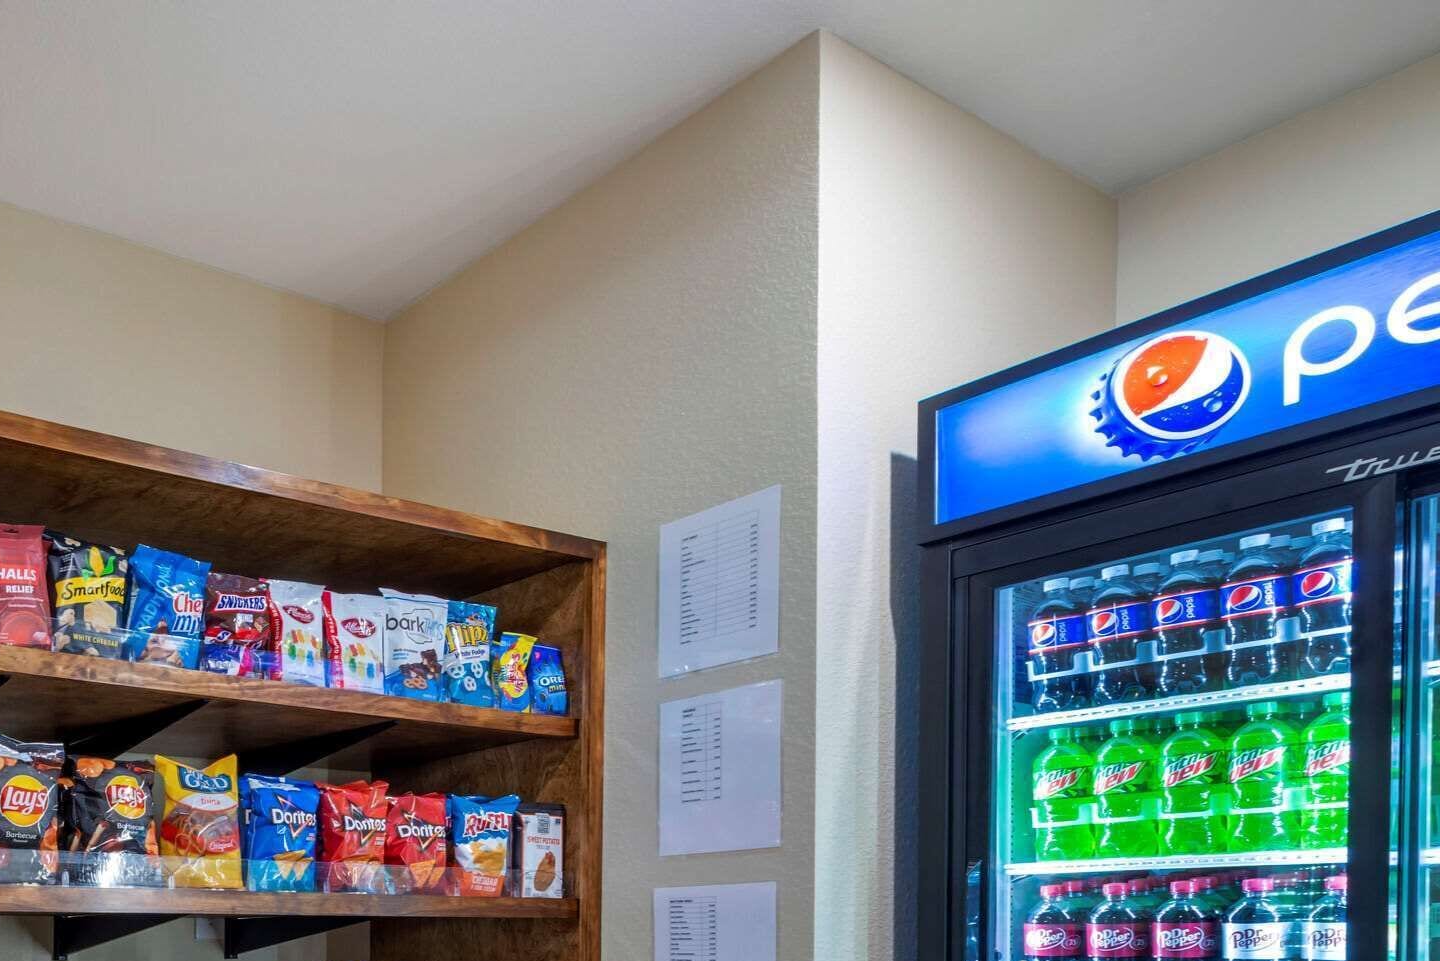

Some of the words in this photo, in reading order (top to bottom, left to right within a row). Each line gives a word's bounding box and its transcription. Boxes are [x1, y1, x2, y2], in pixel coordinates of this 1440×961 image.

[5, 585, 34, 594] RELIEF
[1263, 580, 1273, 605] pepsi
[173, 592, 203, 613] Che
[217, 595, 265, 610] SNICKERS
[1185, 597, 1195, 619] pepsi
[1121, 609, 1130, 630] pepsi
[72, 633, 92, 642] WHITE
[3, 786, 48, 817] Lay's
[272, 809, 316, 825] Doritos
[344, 816, 386, 831] Doritos
[465, 812, 513, 837] RUFFL
[5, 831, 38, 840] Barbecue
[398, 824, 446, 838] Doritos
[1103, 928, 1119, 939] Dr
[1160, 929, 1201, 949] Pepper
[1171, 928, 1189, 938] Dr
[1232, 930, 1272, 949] Pepper
[1245, 928, 1263, 938] Dr
[1311, 930, 1346, 948] Pepp
